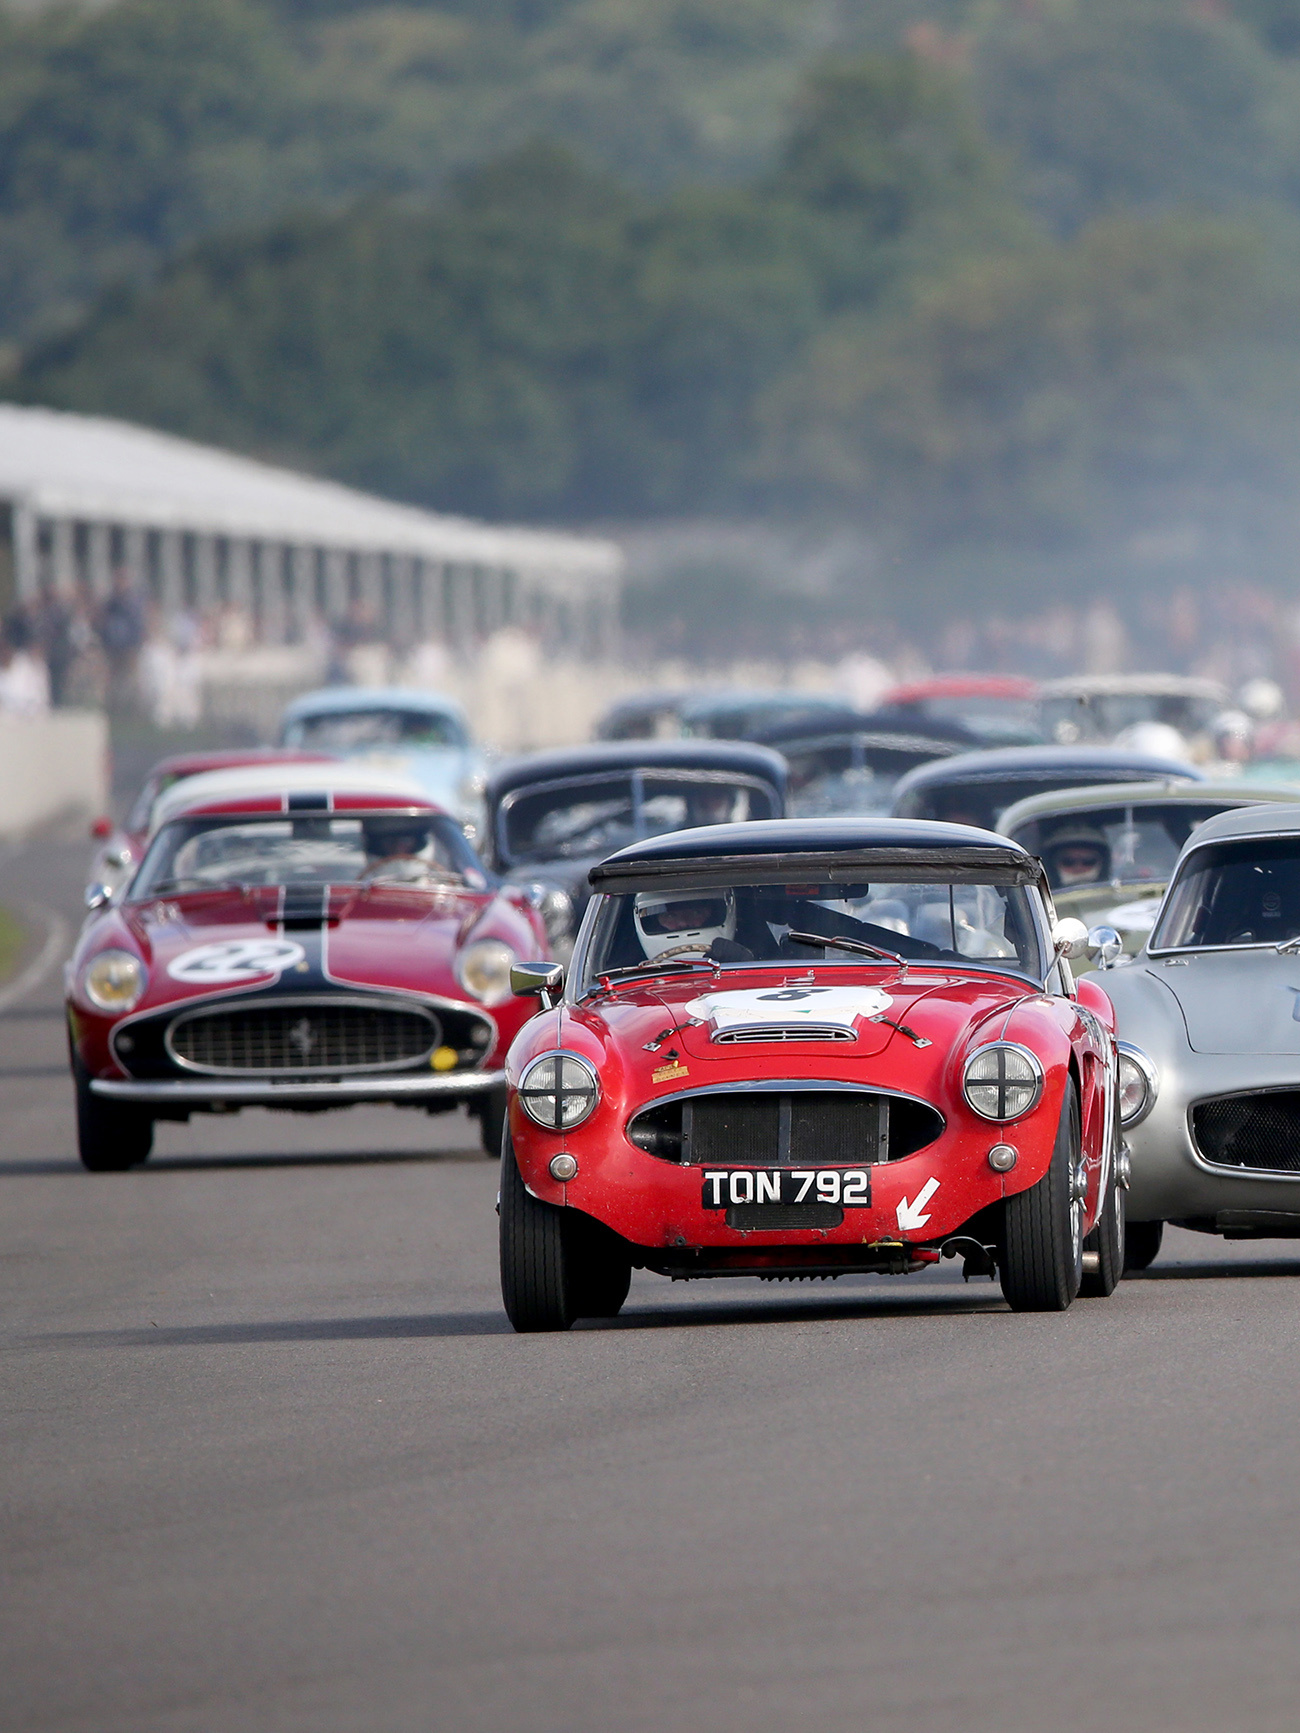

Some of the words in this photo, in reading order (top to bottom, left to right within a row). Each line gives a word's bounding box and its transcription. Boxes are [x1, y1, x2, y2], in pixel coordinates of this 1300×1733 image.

[756, 989, 833, 1002] 8
[704, 1171, 781, 1205] TON
[790, 1170, 868, 1204] 792
